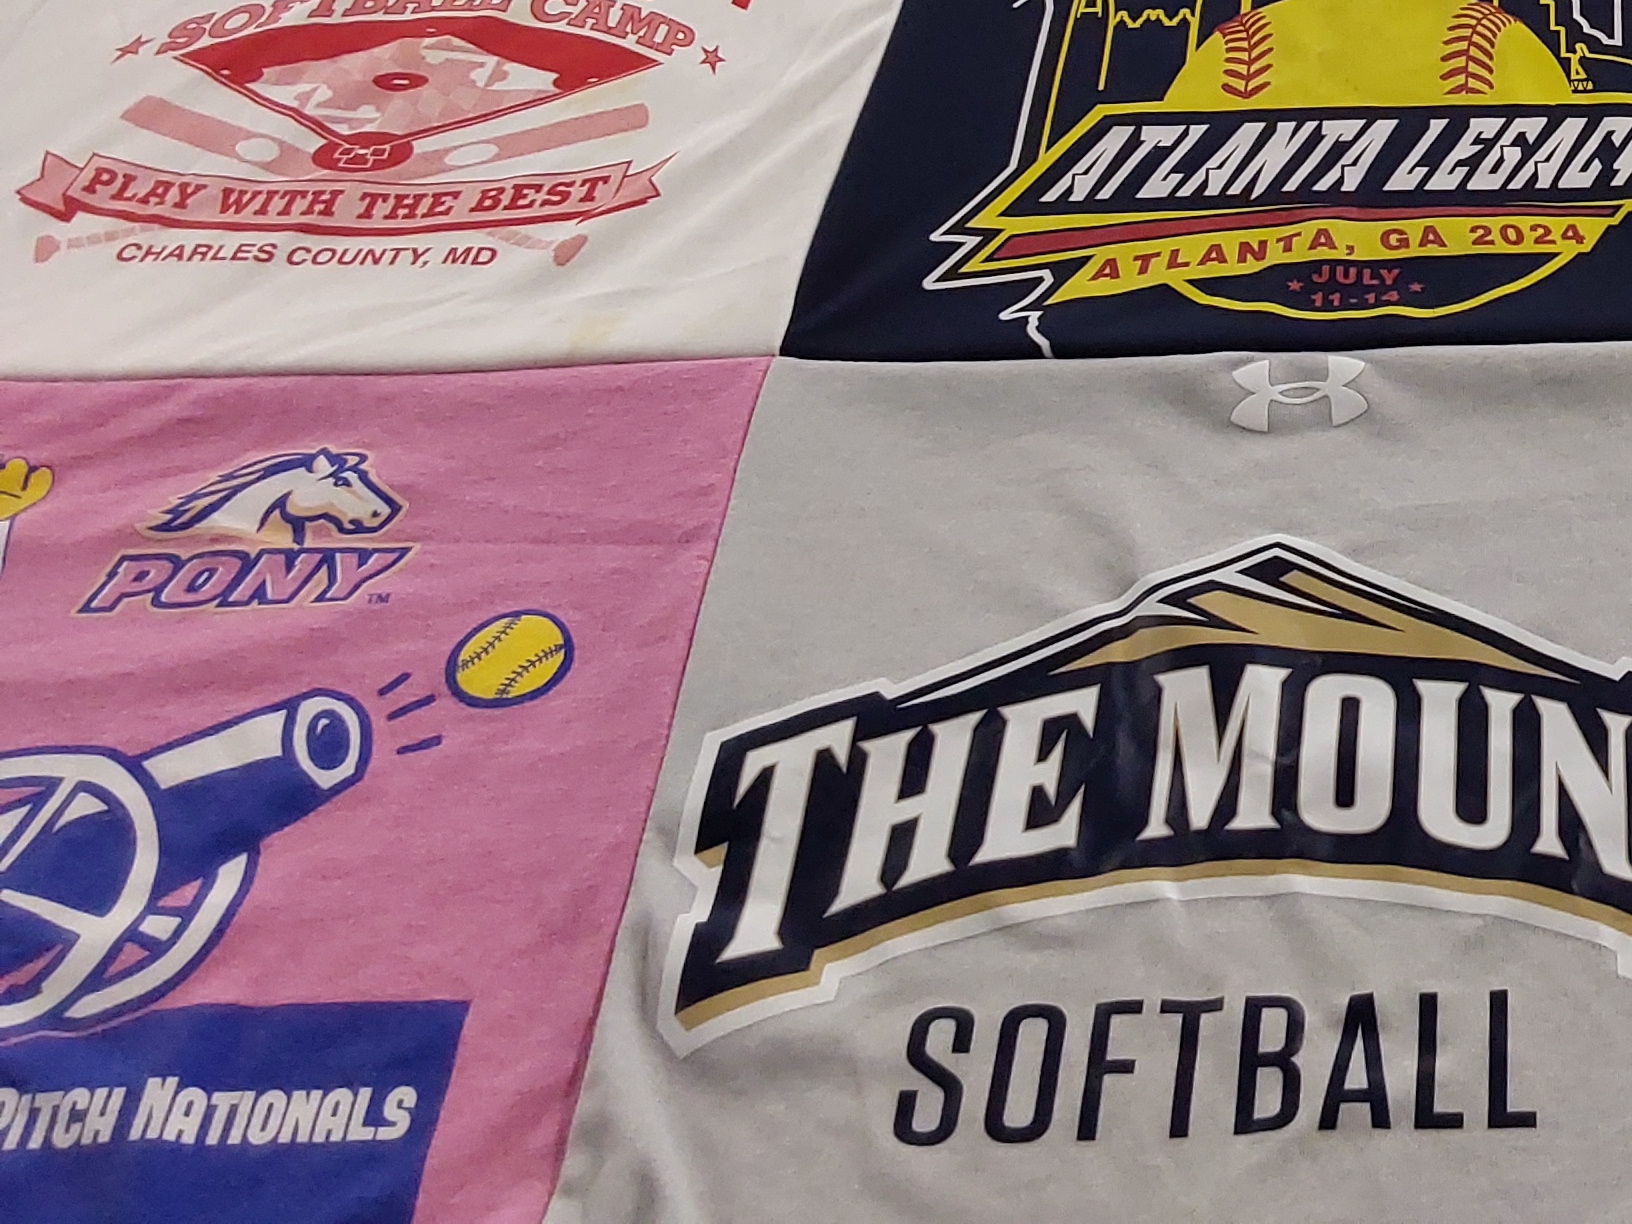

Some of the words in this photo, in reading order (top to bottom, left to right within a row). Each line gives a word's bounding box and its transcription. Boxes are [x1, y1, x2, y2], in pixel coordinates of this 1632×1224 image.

[1039, 118, 1391, 204] ATLANTA
[80, 165, 206, 214] PLAY
[216, 184, 346, 222] WITH
[359, 185, 462, 222] THE
[477, 173, 612, 216] BEST
[115, 240, 278, 266] CHARLES
[284, 242, 431, 270] COUNTY,
[441, 244, 499, 268] MD
[1085, 226, 1357, 284] ATLANTA,
[1379, 221, 1448, 251] GA
[1470, 221, 1588, 249] 2024
[1311, 265, 1401, 285] JULY
[1310, 290, 1400, 307] 11-14
[76, 545, 416, 615] PONY
[713, 680, 1102, 964] THE
[893, 987, 1538, 1149] SOFTBALL
